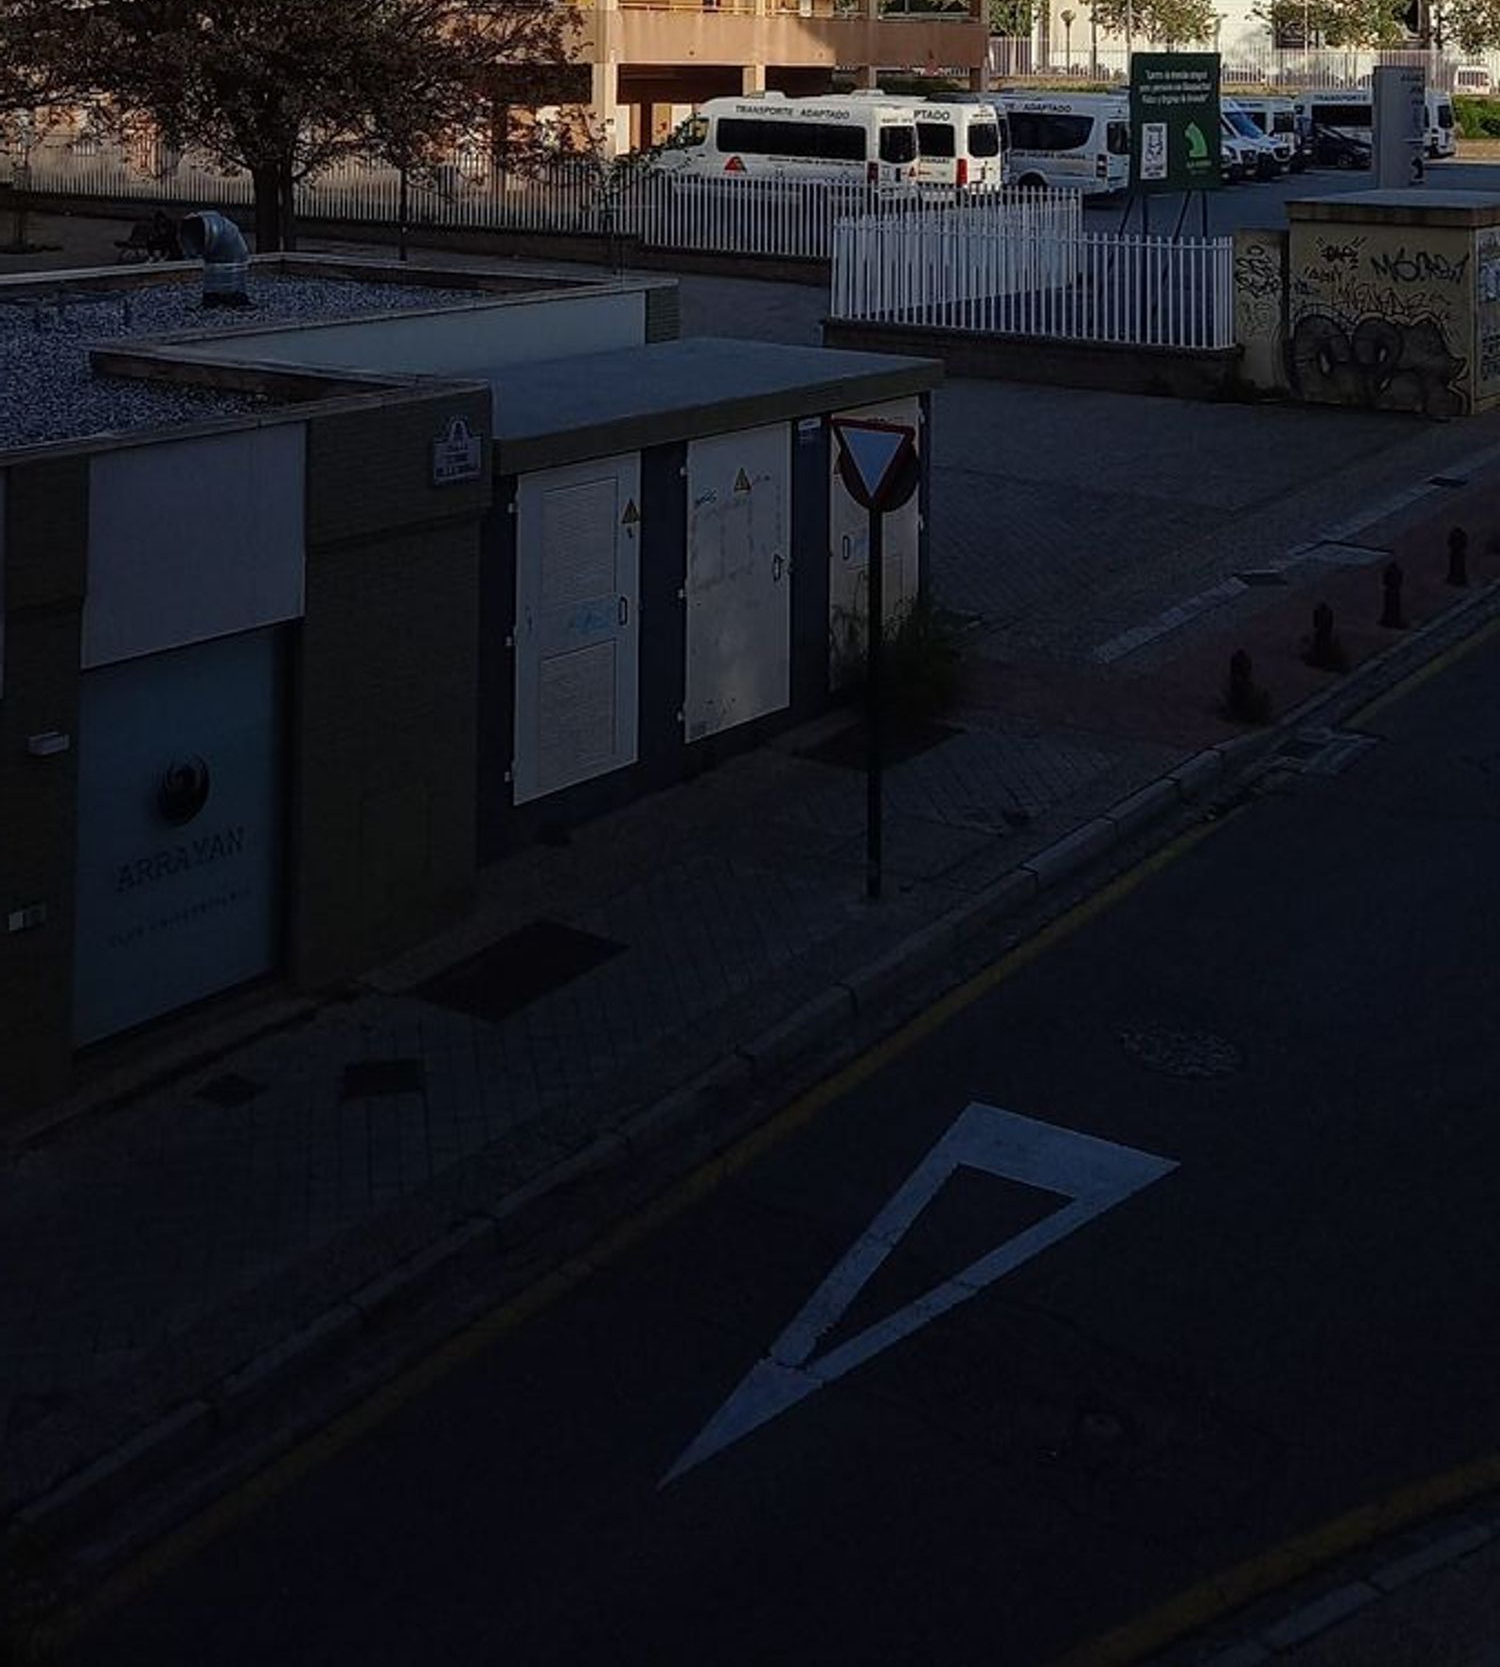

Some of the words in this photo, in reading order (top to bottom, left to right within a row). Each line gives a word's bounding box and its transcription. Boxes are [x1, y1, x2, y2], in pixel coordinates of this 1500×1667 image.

[1313, 93, 1368, 103] TRANSPORTE
[735, 104, 794, 118] TRANSPORTE
[800, 108, 851, 120] ADAPTADO
[1023, 103, 1073, 113] ADAPTADO
[913, 109, 951, 122] PTADO
